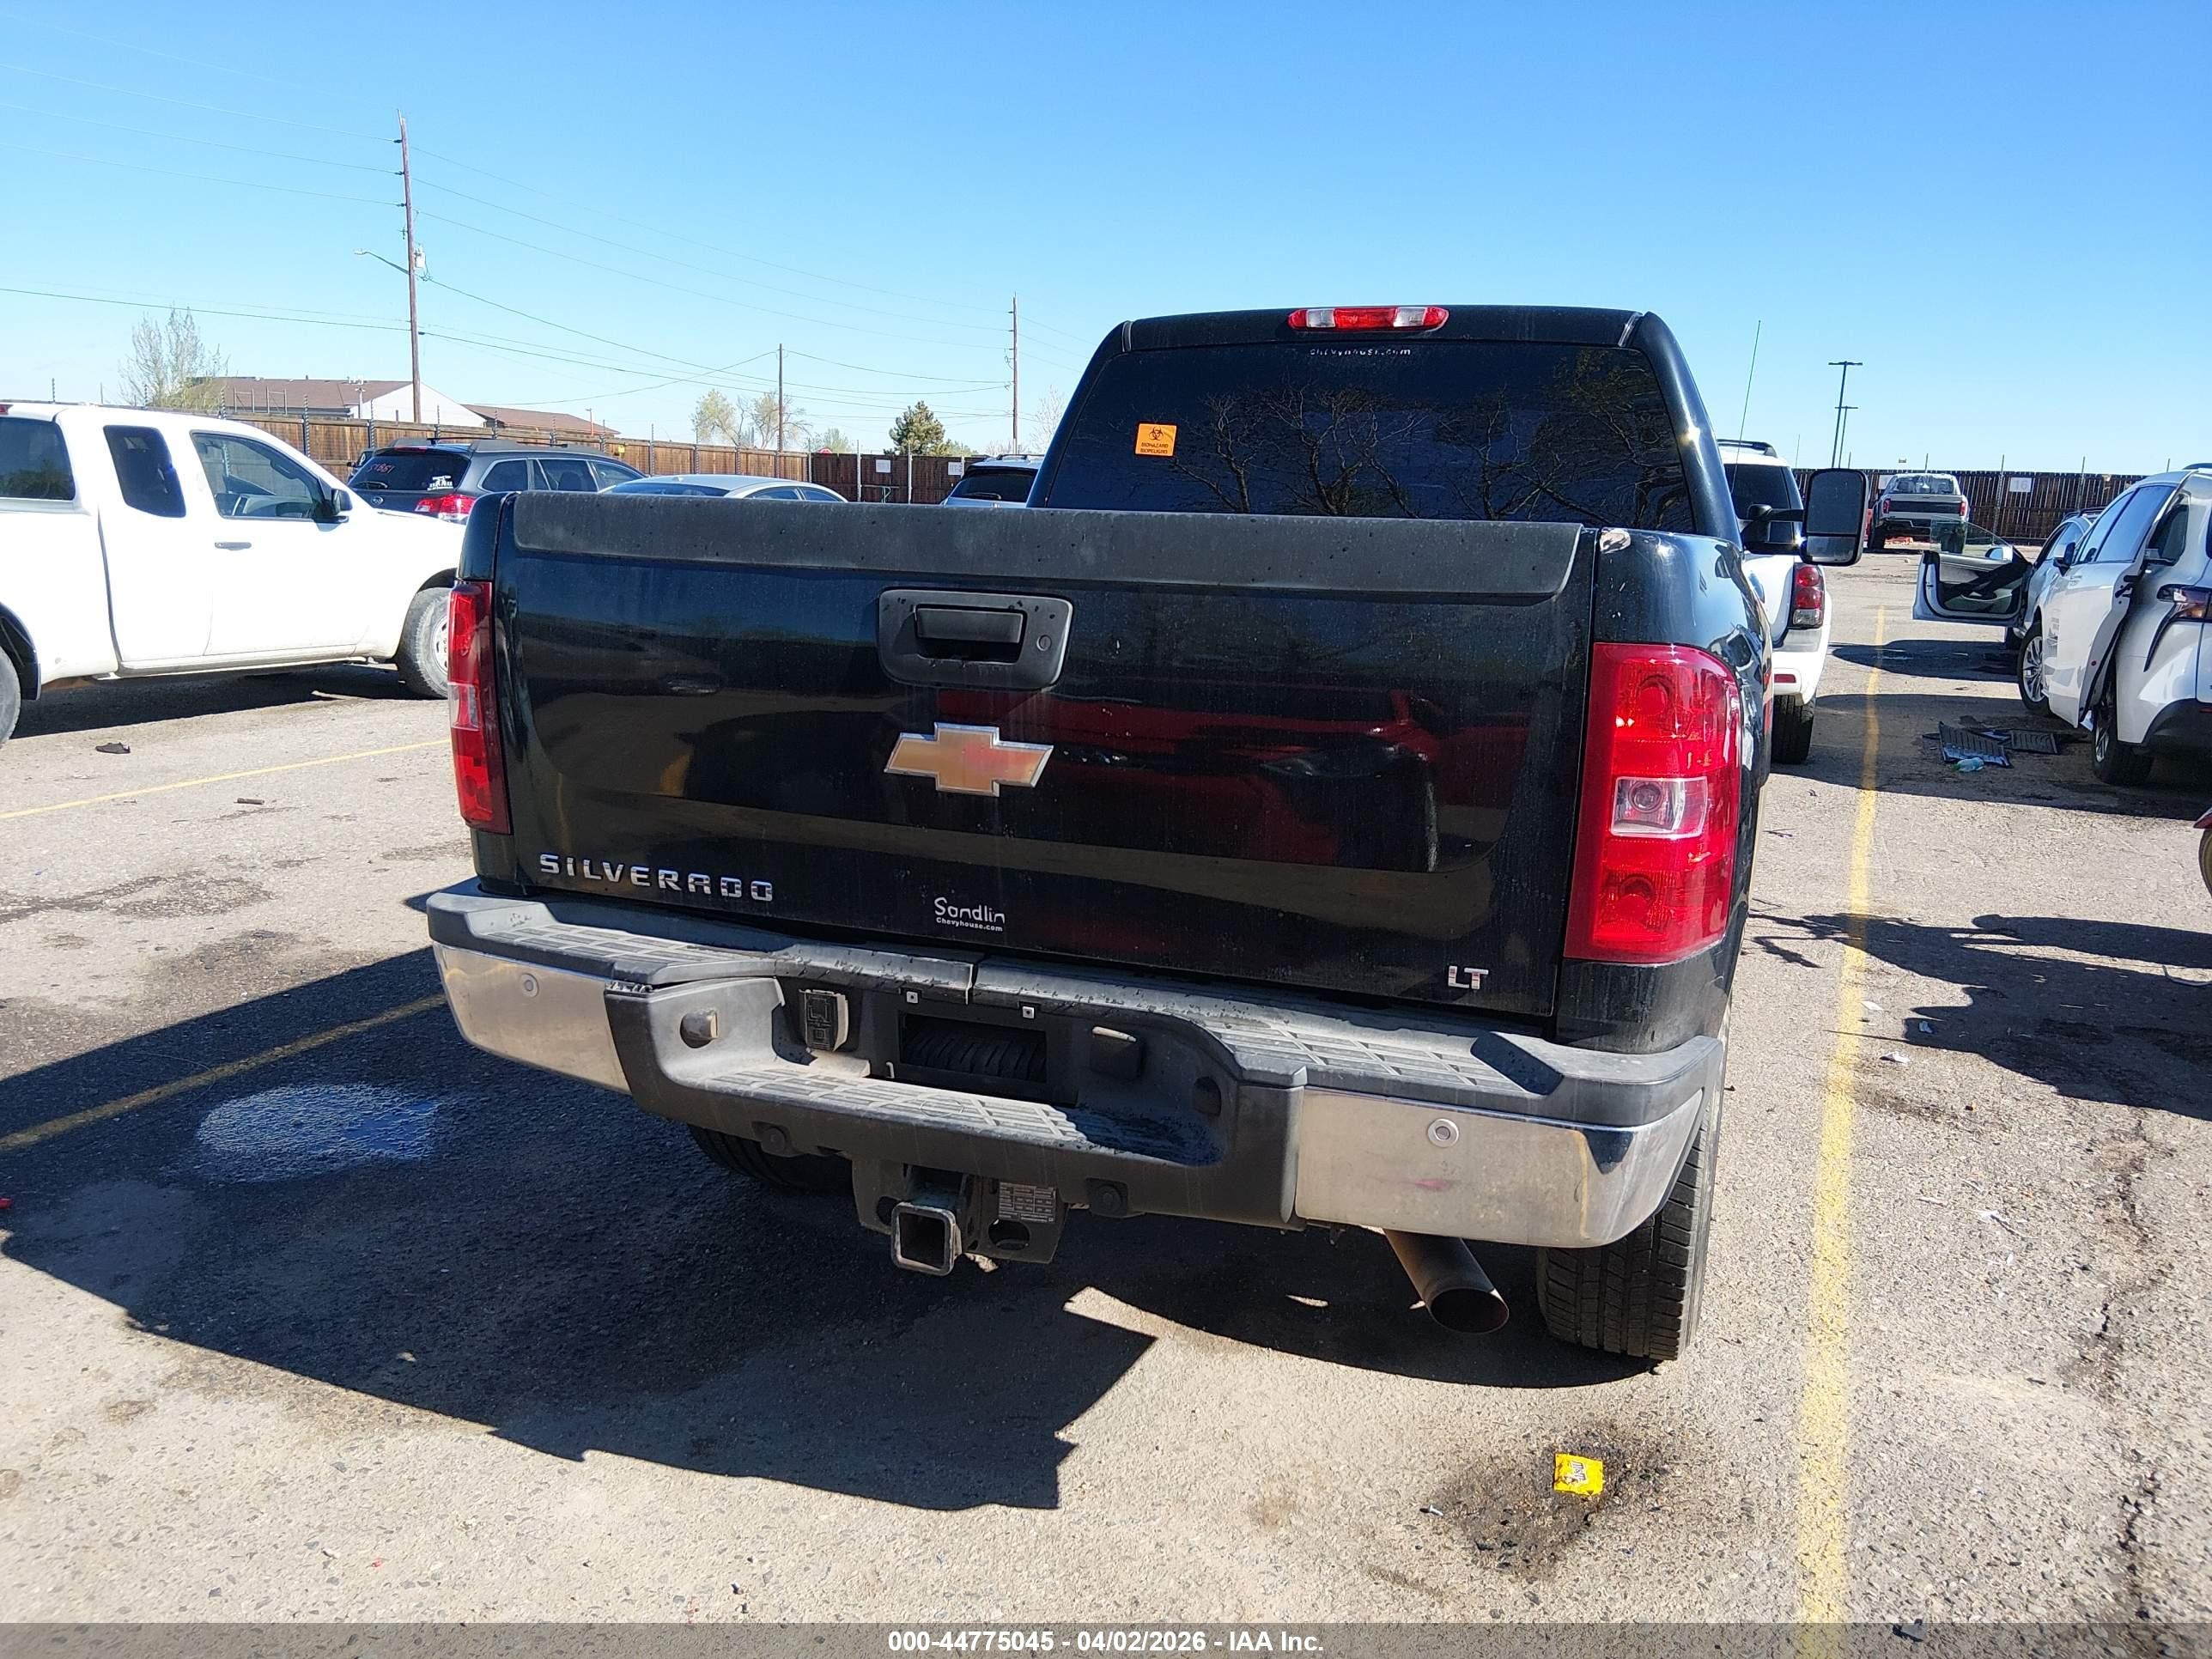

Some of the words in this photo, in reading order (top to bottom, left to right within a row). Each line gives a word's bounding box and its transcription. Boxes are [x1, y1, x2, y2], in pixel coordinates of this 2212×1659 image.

[539, 853, 774, 902] SILVERADO
[934, 896, 1006, 924] Sandlin
[1448, 965, 1489, 989] LT
